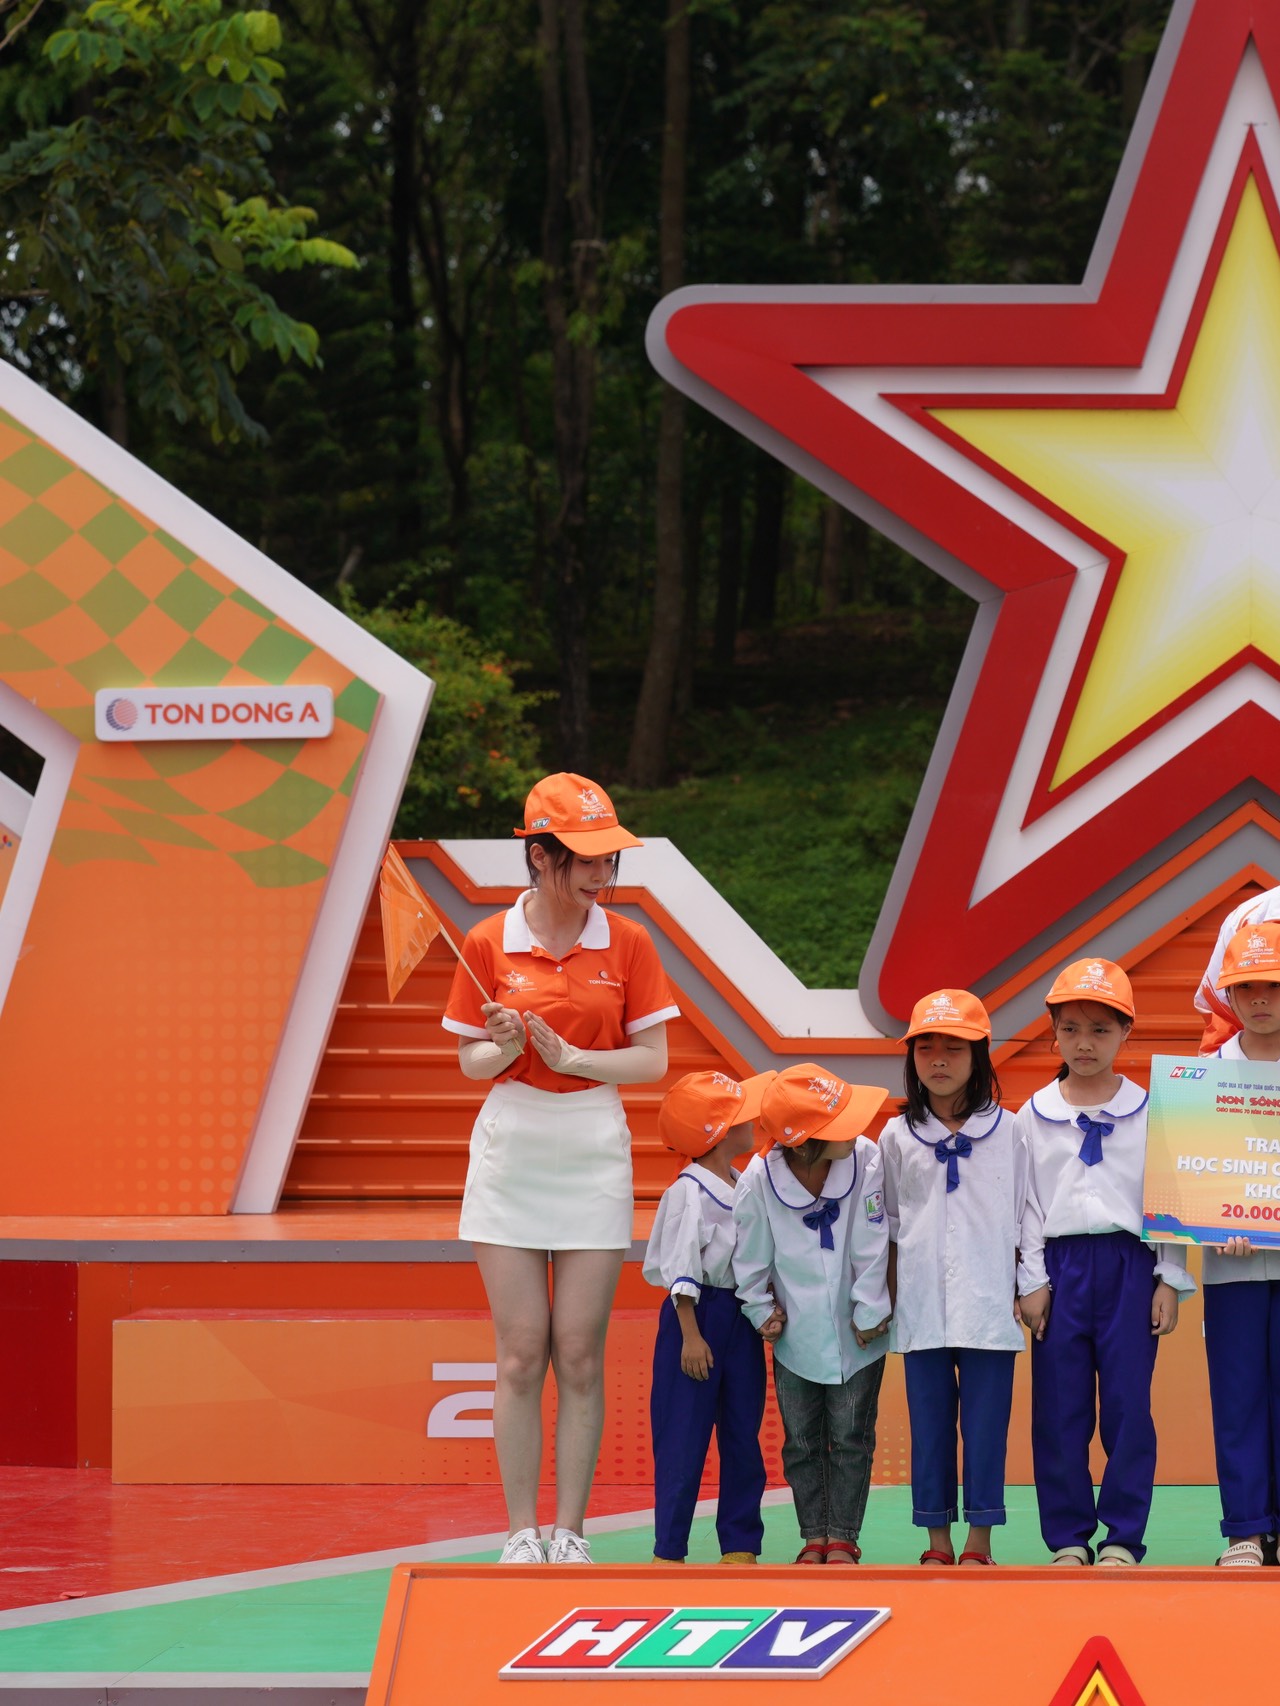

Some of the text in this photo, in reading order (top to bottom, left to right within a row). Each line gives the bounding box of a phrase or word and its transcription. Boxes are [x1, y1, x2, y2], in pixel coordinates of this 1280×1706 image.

[144, 702, 320, 725] TON DONG A
[1171, 1067, 1205, 1079] HTV
[1216, 1094, 1244, 1105] NON
[1177, 1155, 1217, 1175] HỌC
[1222, 1159, 1267, 1175] SINH
[535, 1619, 857, 1656] HTV
